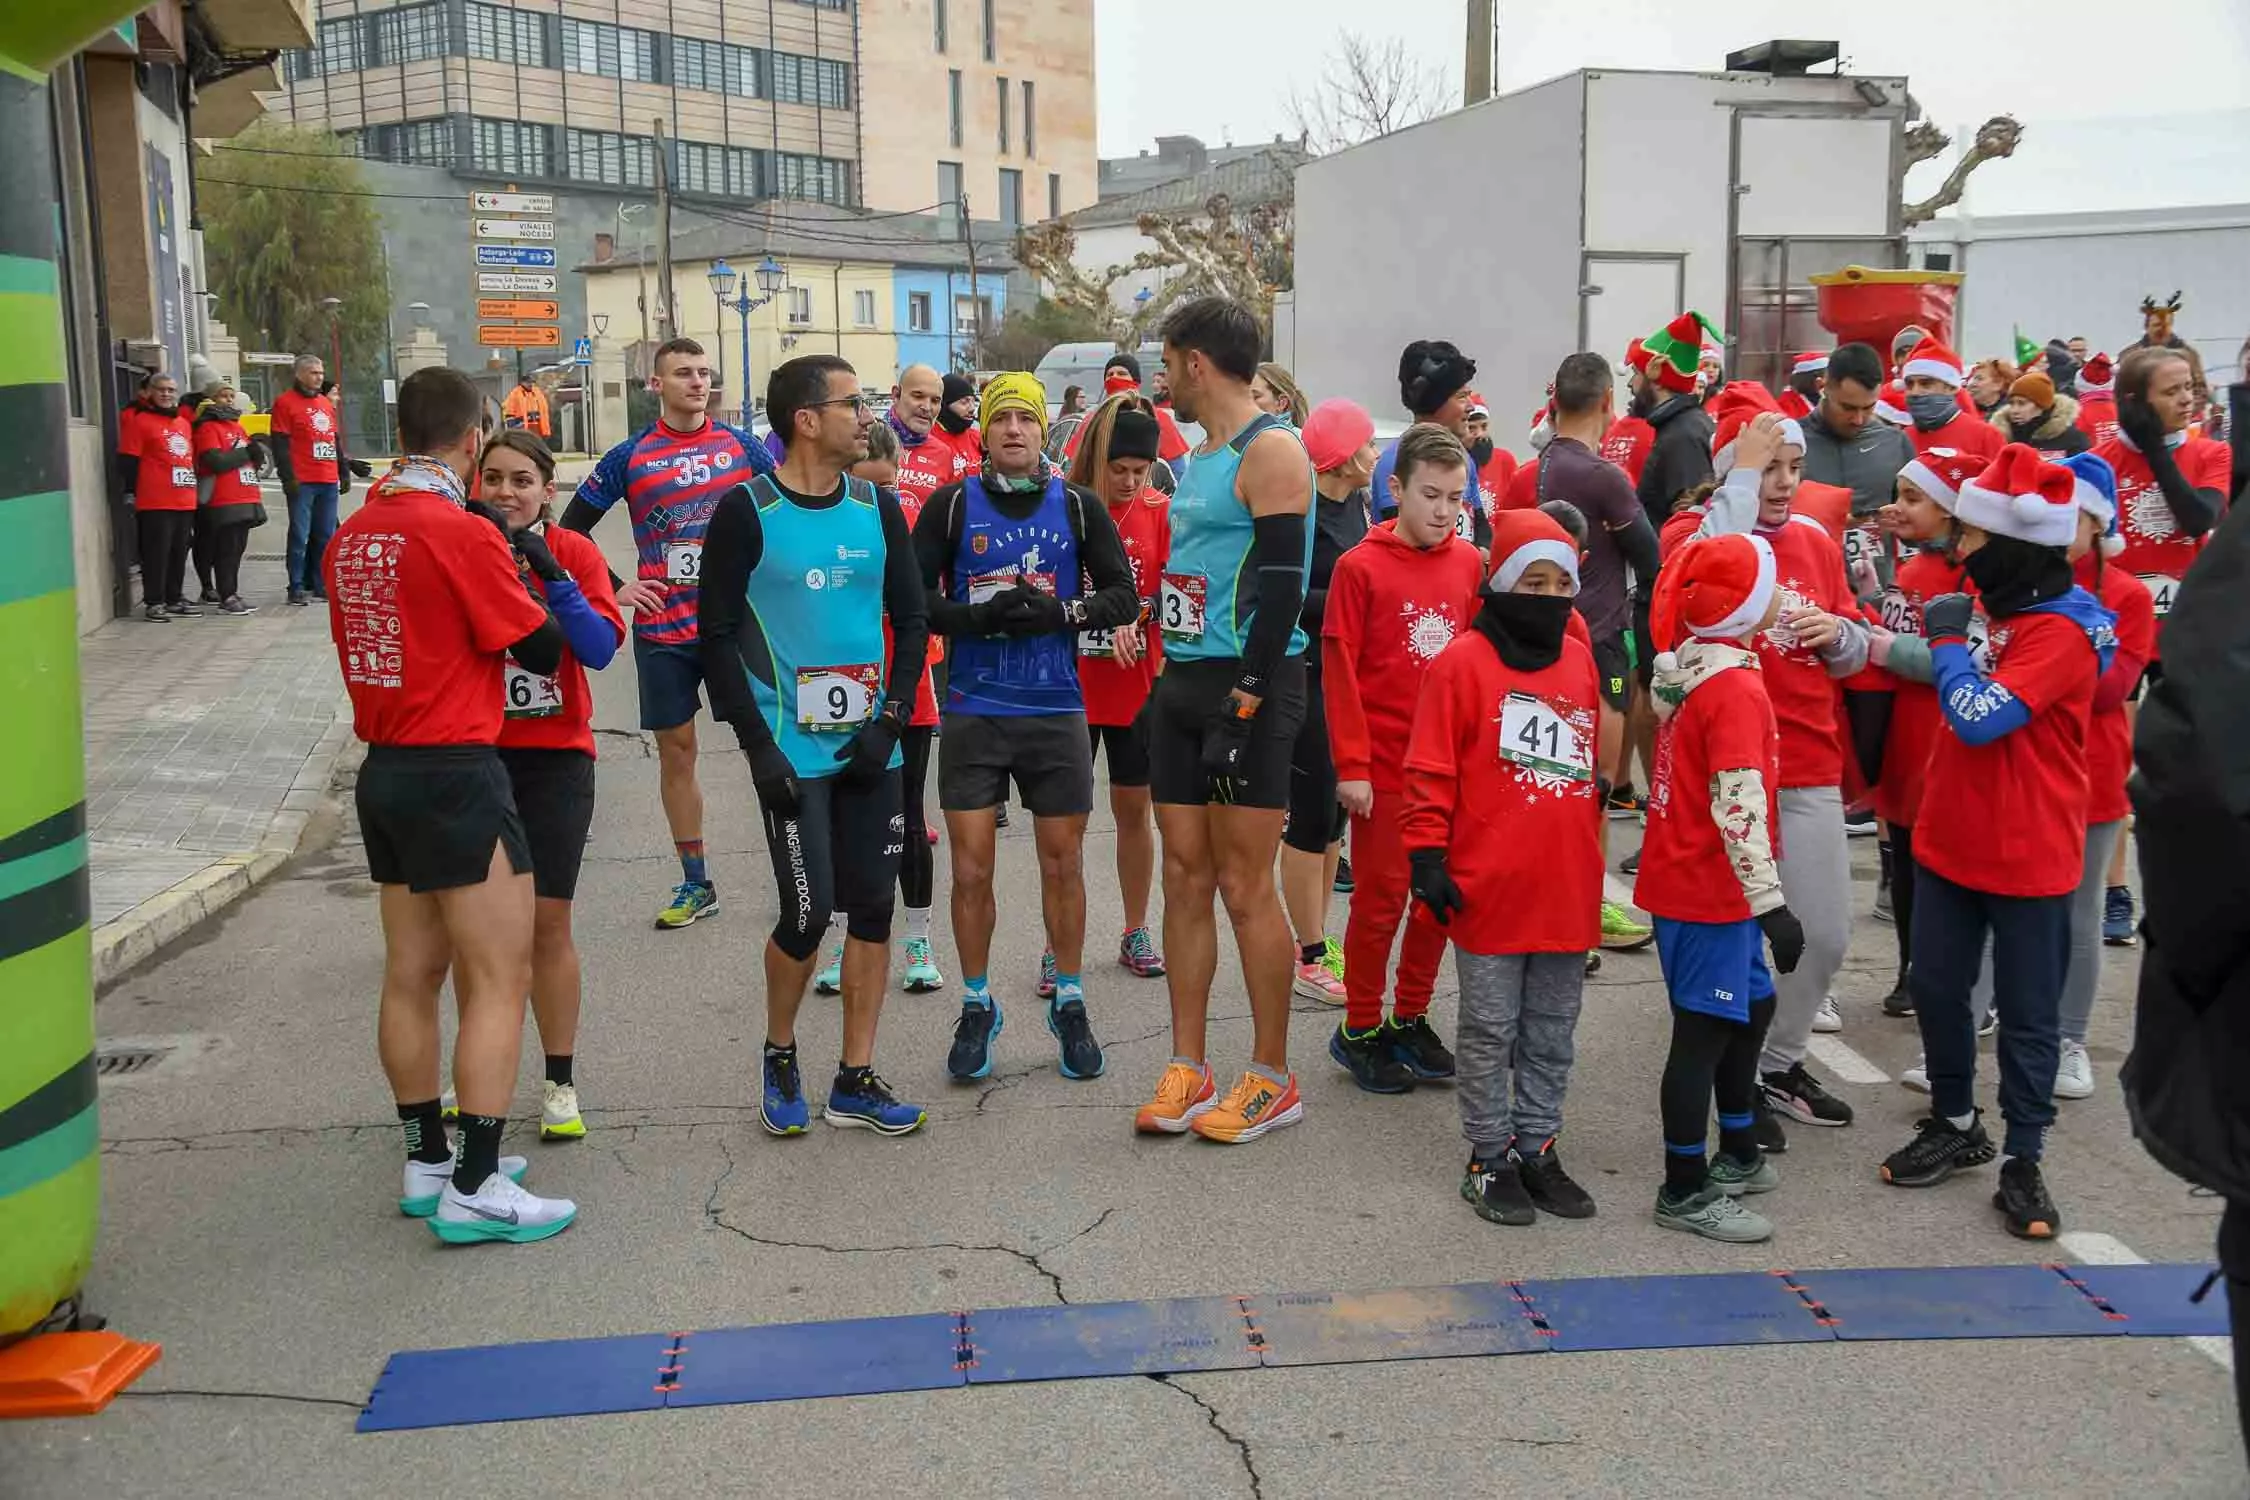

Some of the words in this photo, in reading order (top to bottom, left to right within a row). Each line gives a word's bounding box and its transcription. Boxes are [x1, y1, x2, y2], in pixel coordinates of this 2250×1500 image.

[673, 454, 711, 488] 35
[994, 527, 1069, 551] ASTORGA
[680, 553, 703, 577] 3
[1166, 593, 1182, 629] 3
[509, 674, 532, 707] 6
[827, 685, 848, 720] 9
[1518, 715, 1559, 758] 41
[1241, 1089, 1273, 1123] HOKA
